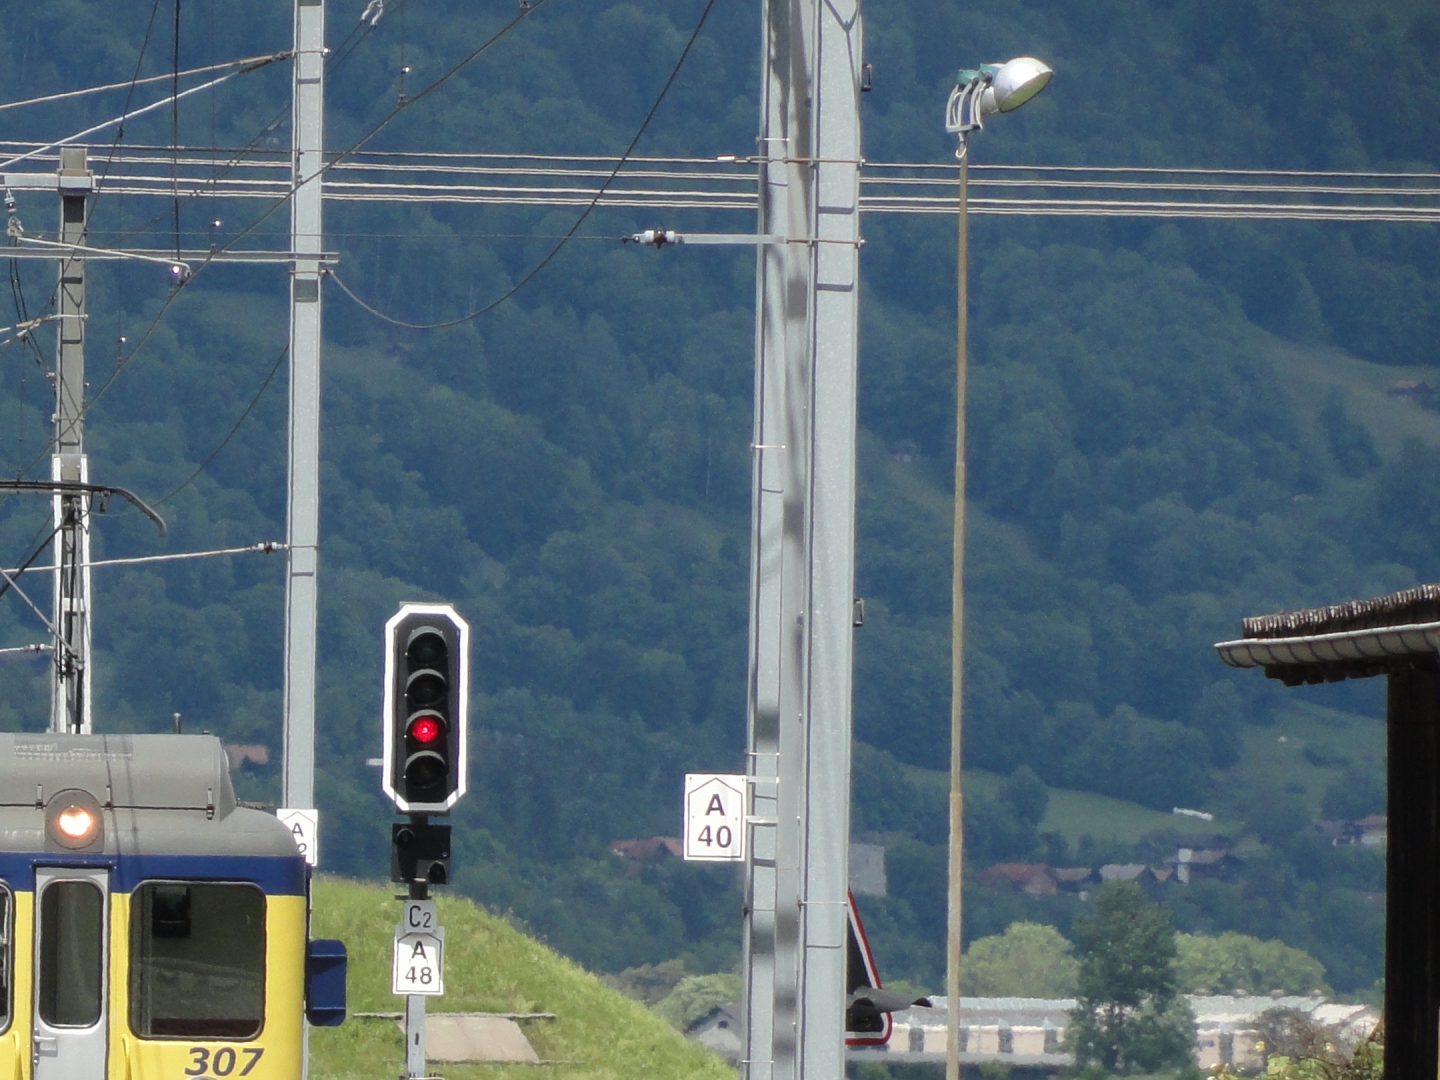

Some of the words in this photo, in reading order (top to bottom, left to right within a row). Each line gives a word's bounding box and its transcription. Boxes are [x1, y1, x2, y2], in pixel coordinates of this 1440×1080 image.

[705, 793, 725, 816] A
[697, 825, 732, 848] 40
[409, 905, 432, 928] C2
[411, 940, 427, 960] A
[405, 966, 432, 985] 48
[184, 1046, 265, 1076] 307
